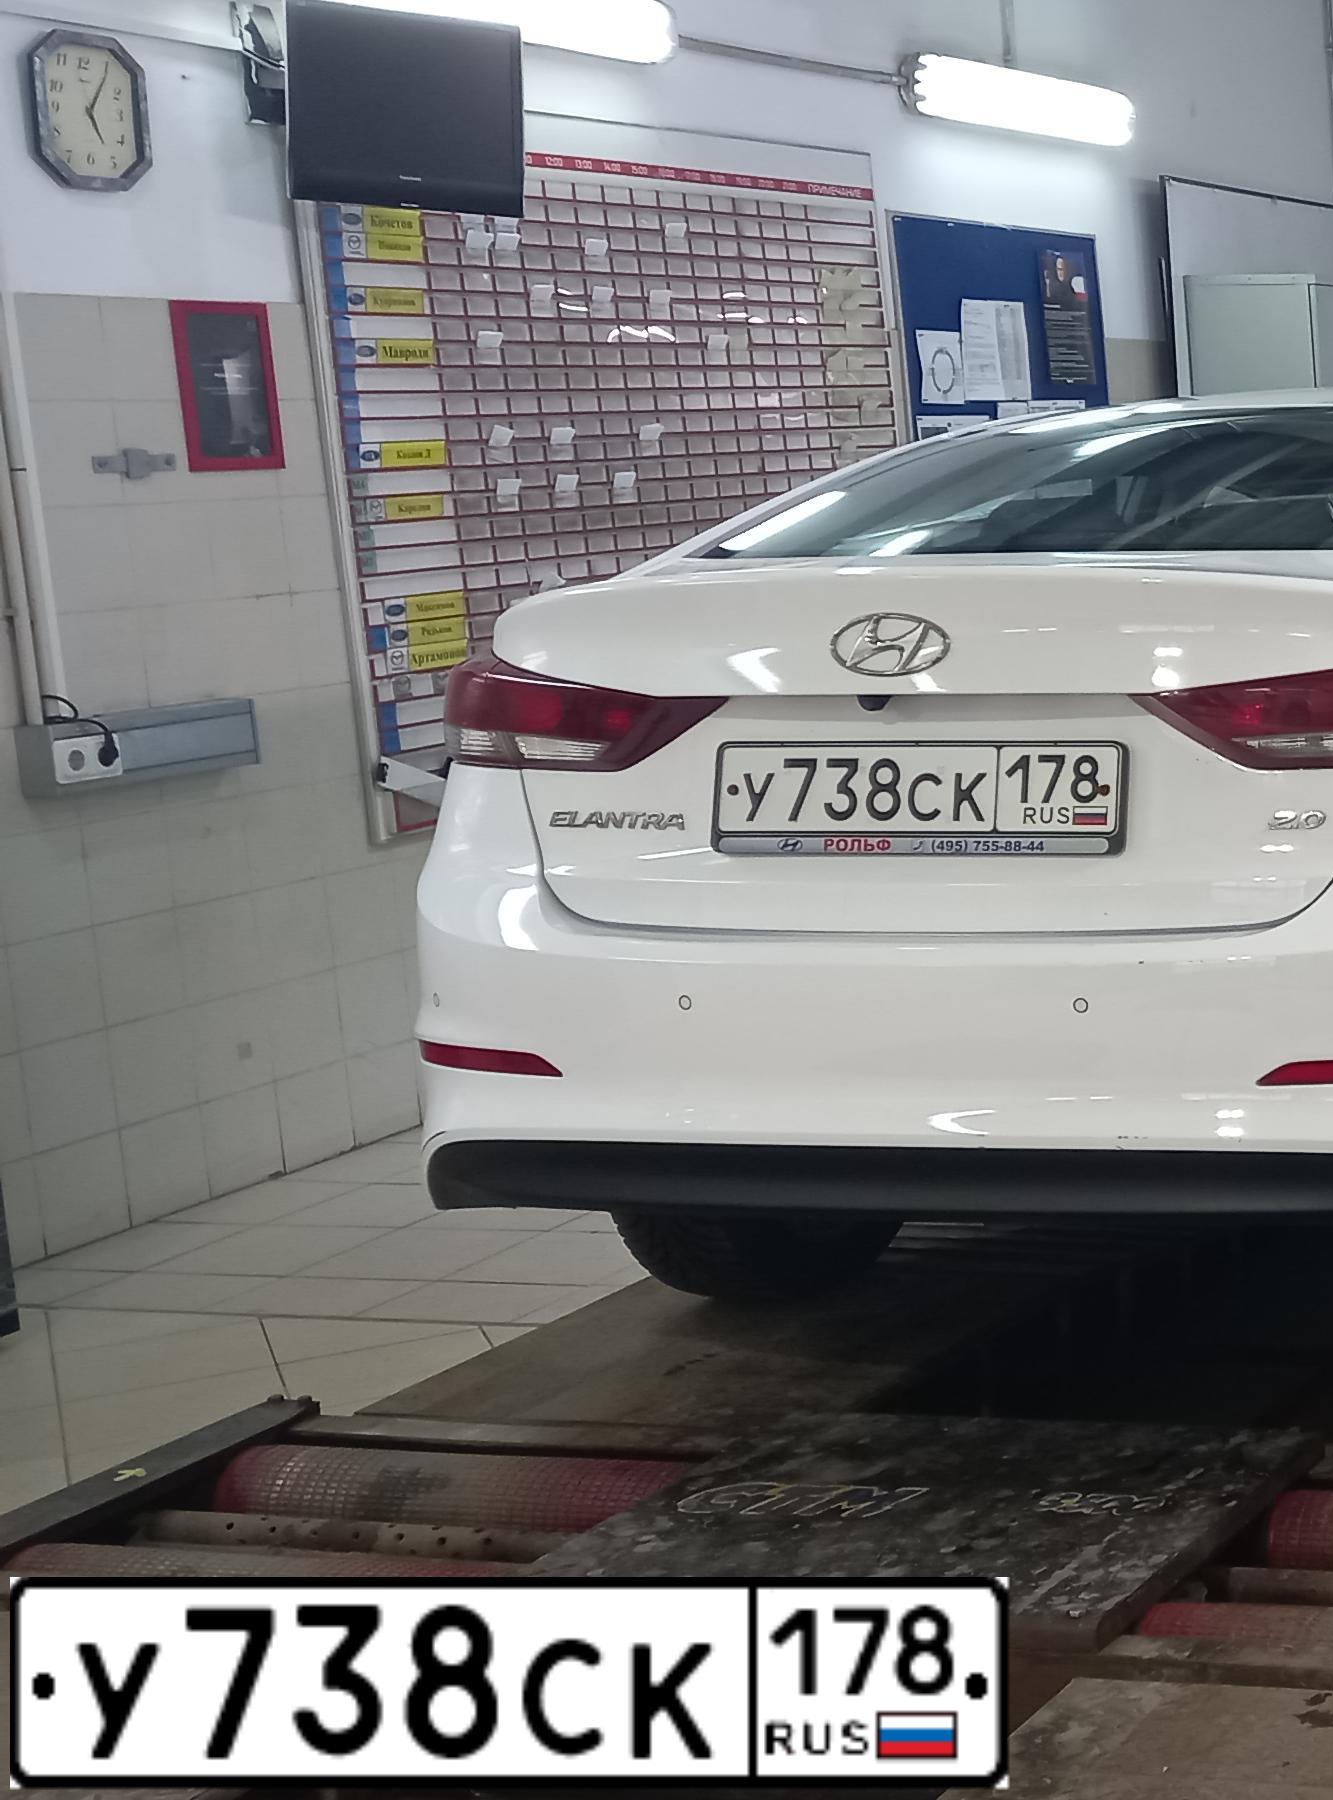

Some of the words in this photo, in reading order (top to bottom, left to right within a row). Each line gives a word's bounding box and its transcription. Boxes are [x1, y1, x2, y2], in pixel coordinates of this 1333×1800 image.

[55, 53, 67, 66] 11
[77, 57, 90, 70] 12
[49, 79, 63, 93] 10
[807, 183, 863, 199] ПРИМЕЧАНИЕ
[742, 757, 989, 823] У738СК
[1004, 754, 1100, 805] 178
[549, 810, 686, 831] ELANTRA
[1022, 805, 1071, 825] RUS
[822, 837, 892, 853] РОЛЬФ
[930, 838, 969, 854] (495)
[972, 839, 1045, 853] 755-88-44
